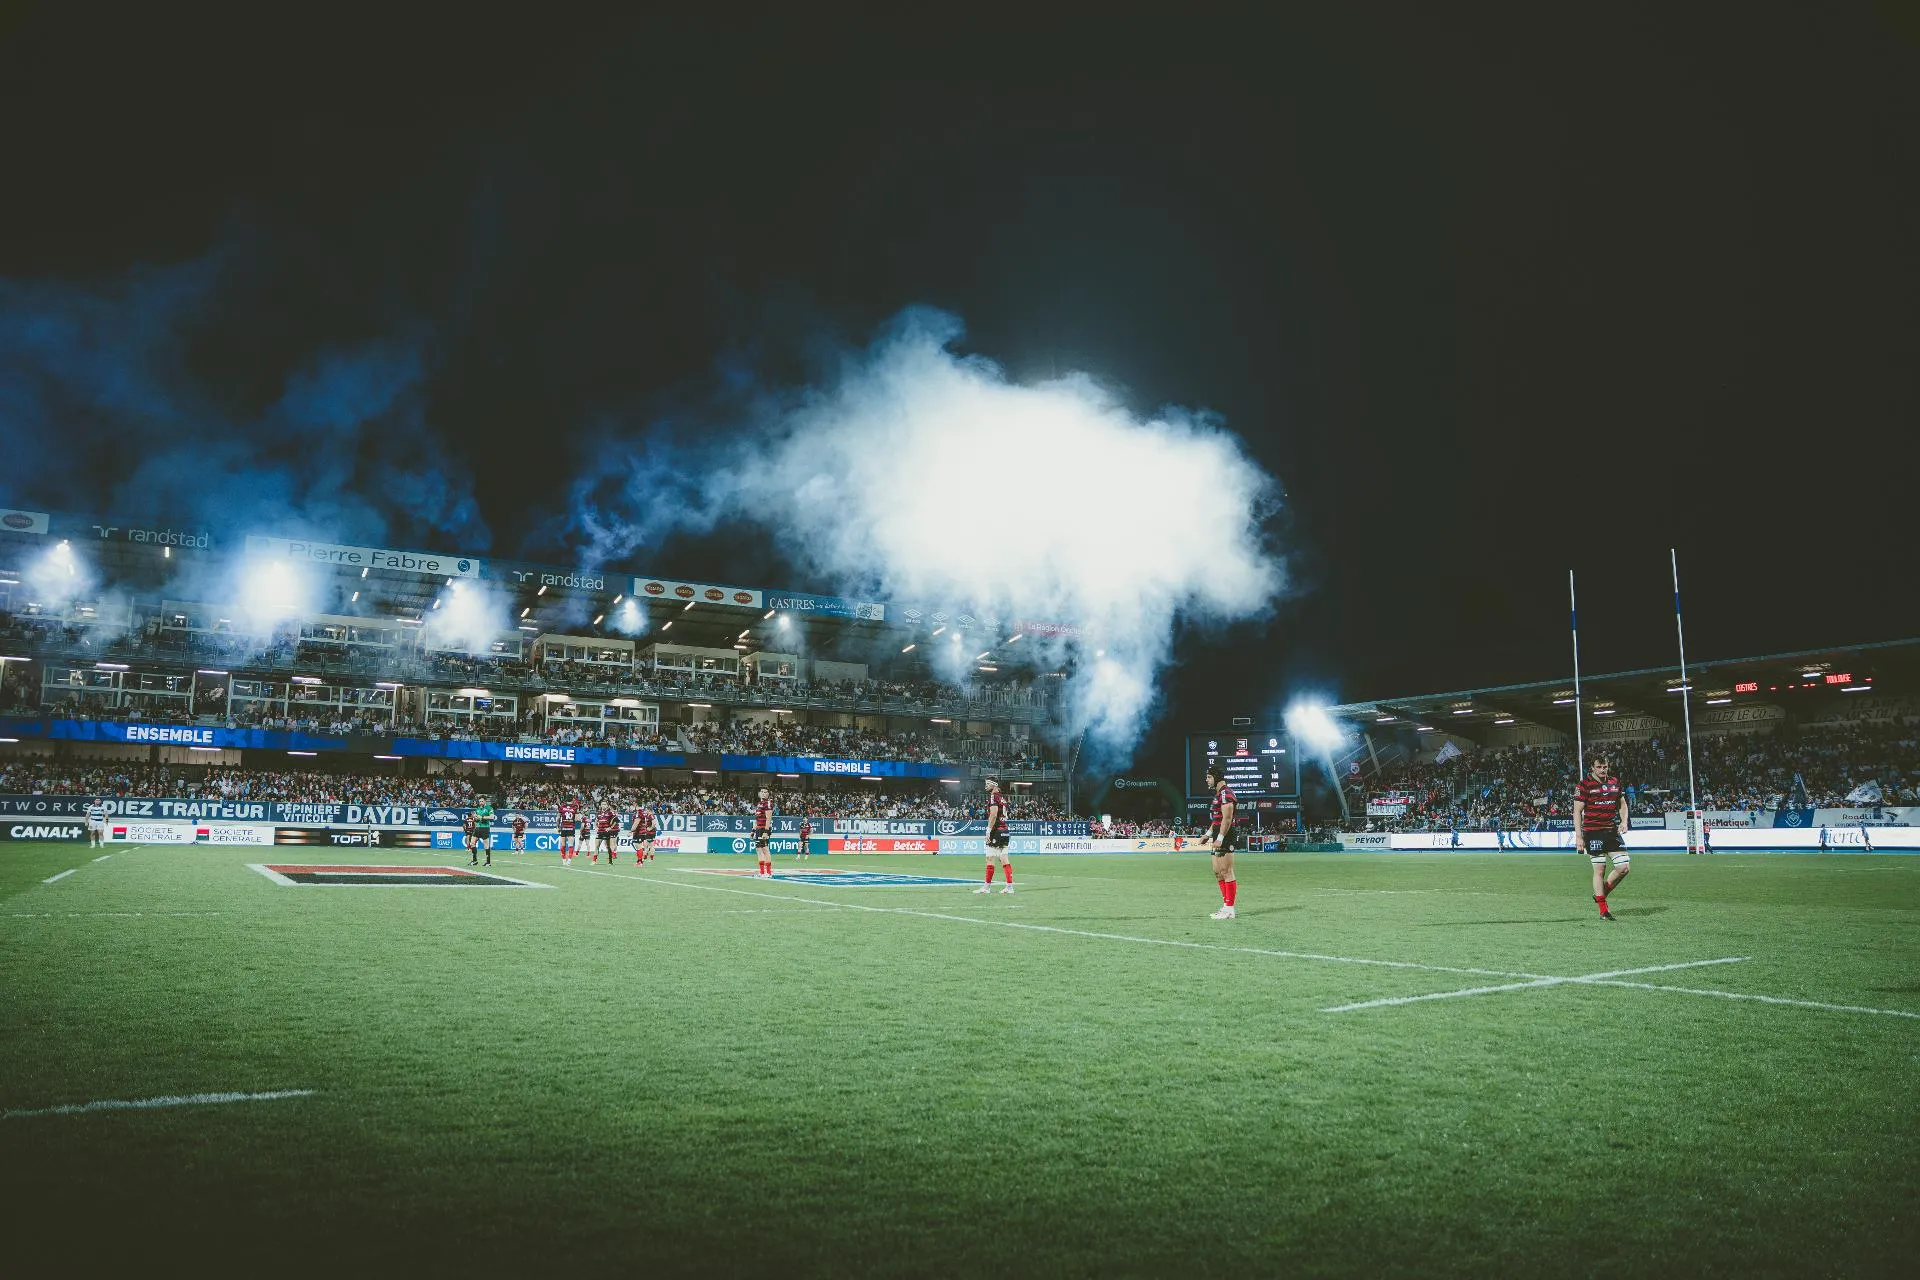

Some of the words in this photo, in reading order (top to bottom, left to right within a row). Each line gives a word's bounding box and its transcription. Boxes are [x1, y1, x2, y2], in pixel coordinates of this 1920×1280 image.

[128, 528, 209, 548] randstad
[289, 542, 362, 563] Pierre
[371, 551, 440, 571] Fabre
[540, 572, 604, 591] randstad
[769, 597, 815, 610] CASTRES
[126, 726, 213, 743] ENSEMBLE
[505, 746, 575, 761] ENSEMBLE
[814, 760, 871, 774] ENSEMBLE
[102, 800, 153, 816] DIEZ
[159, 801, 264, 818] TRAITEUR
[564, 811, 573, 820] 10
[283, 813, 334, 823] VITICOLE
[655, 815, 697, 831] AYDE
[10, 825, 83, 839] CANAL+
[890, 822, 926, 833] CADET
[843, 841, 878, 851] Betclic
[893, 841, 926, 851] Betclic
